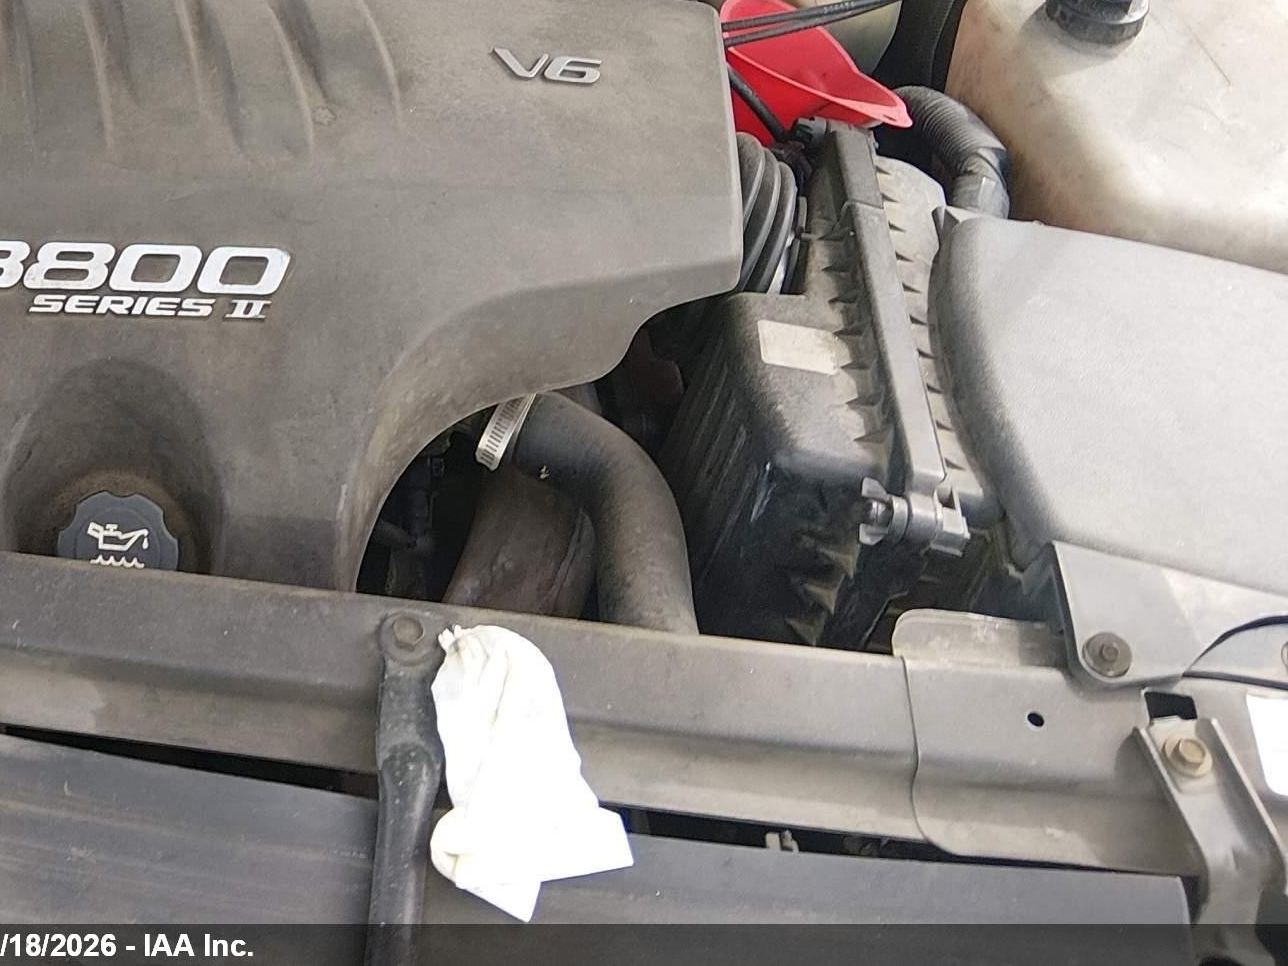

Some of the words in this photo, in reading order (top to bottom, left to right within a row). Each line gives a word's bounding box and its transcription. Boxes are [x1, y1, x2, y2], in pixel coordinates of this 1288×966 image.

[493, 46, 603, 86] V6
[29, 293, 216, 317] SERIES
[224, 298, 273, 319] II
